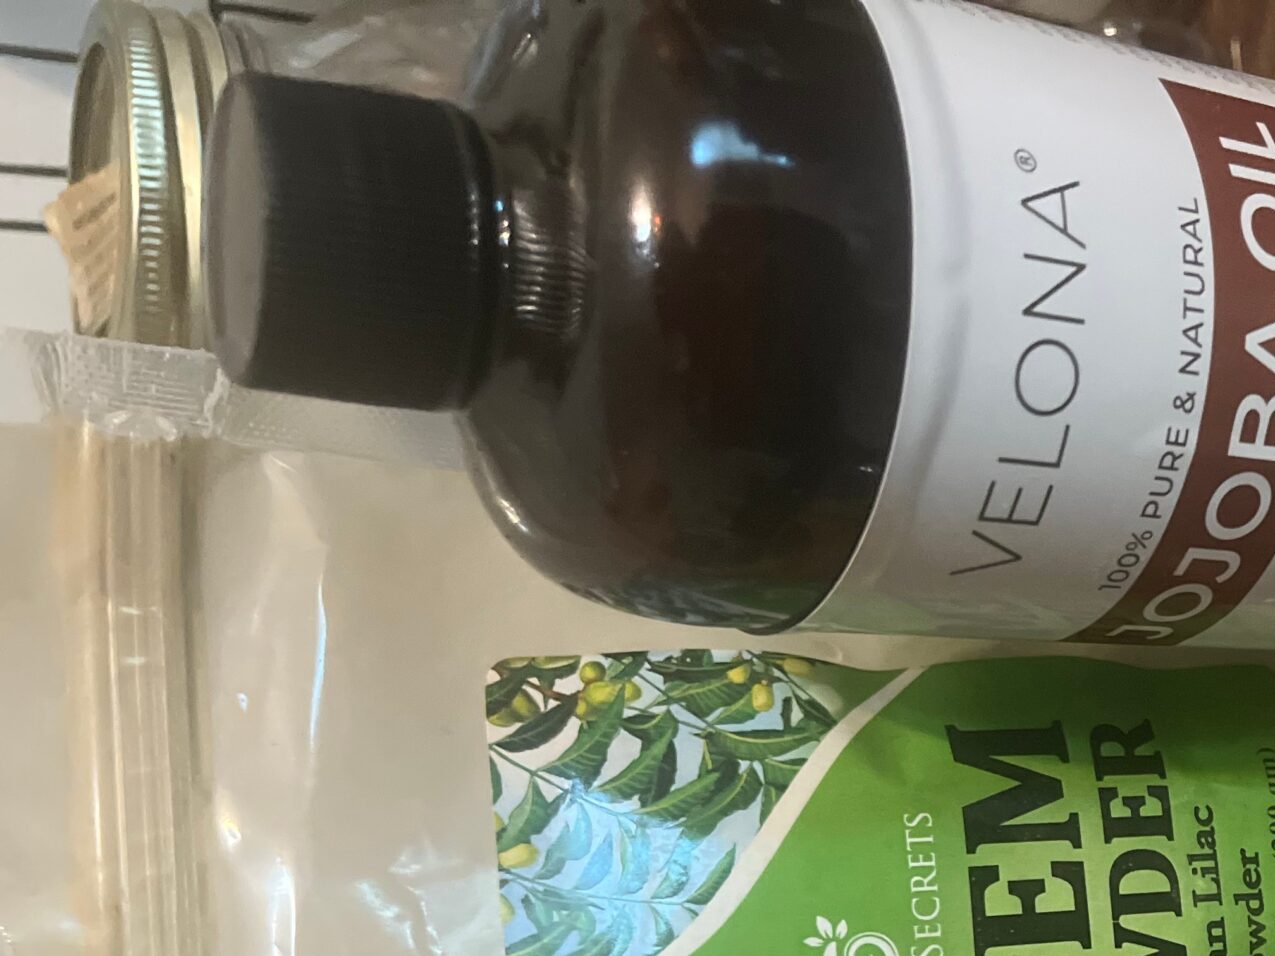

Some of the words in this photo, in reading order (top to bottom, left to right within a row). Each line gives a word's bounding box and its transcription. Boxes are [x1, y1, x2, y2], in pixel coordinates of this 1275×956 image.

[1177, 196, 1207, 376] NATURAL
[1173, 391, 1197, 414] &
[1139, 426, 1190, 519] PURE
[1099, 529, 1154, 593] 100%
[1187, 804, 1224, 908] Lilac
